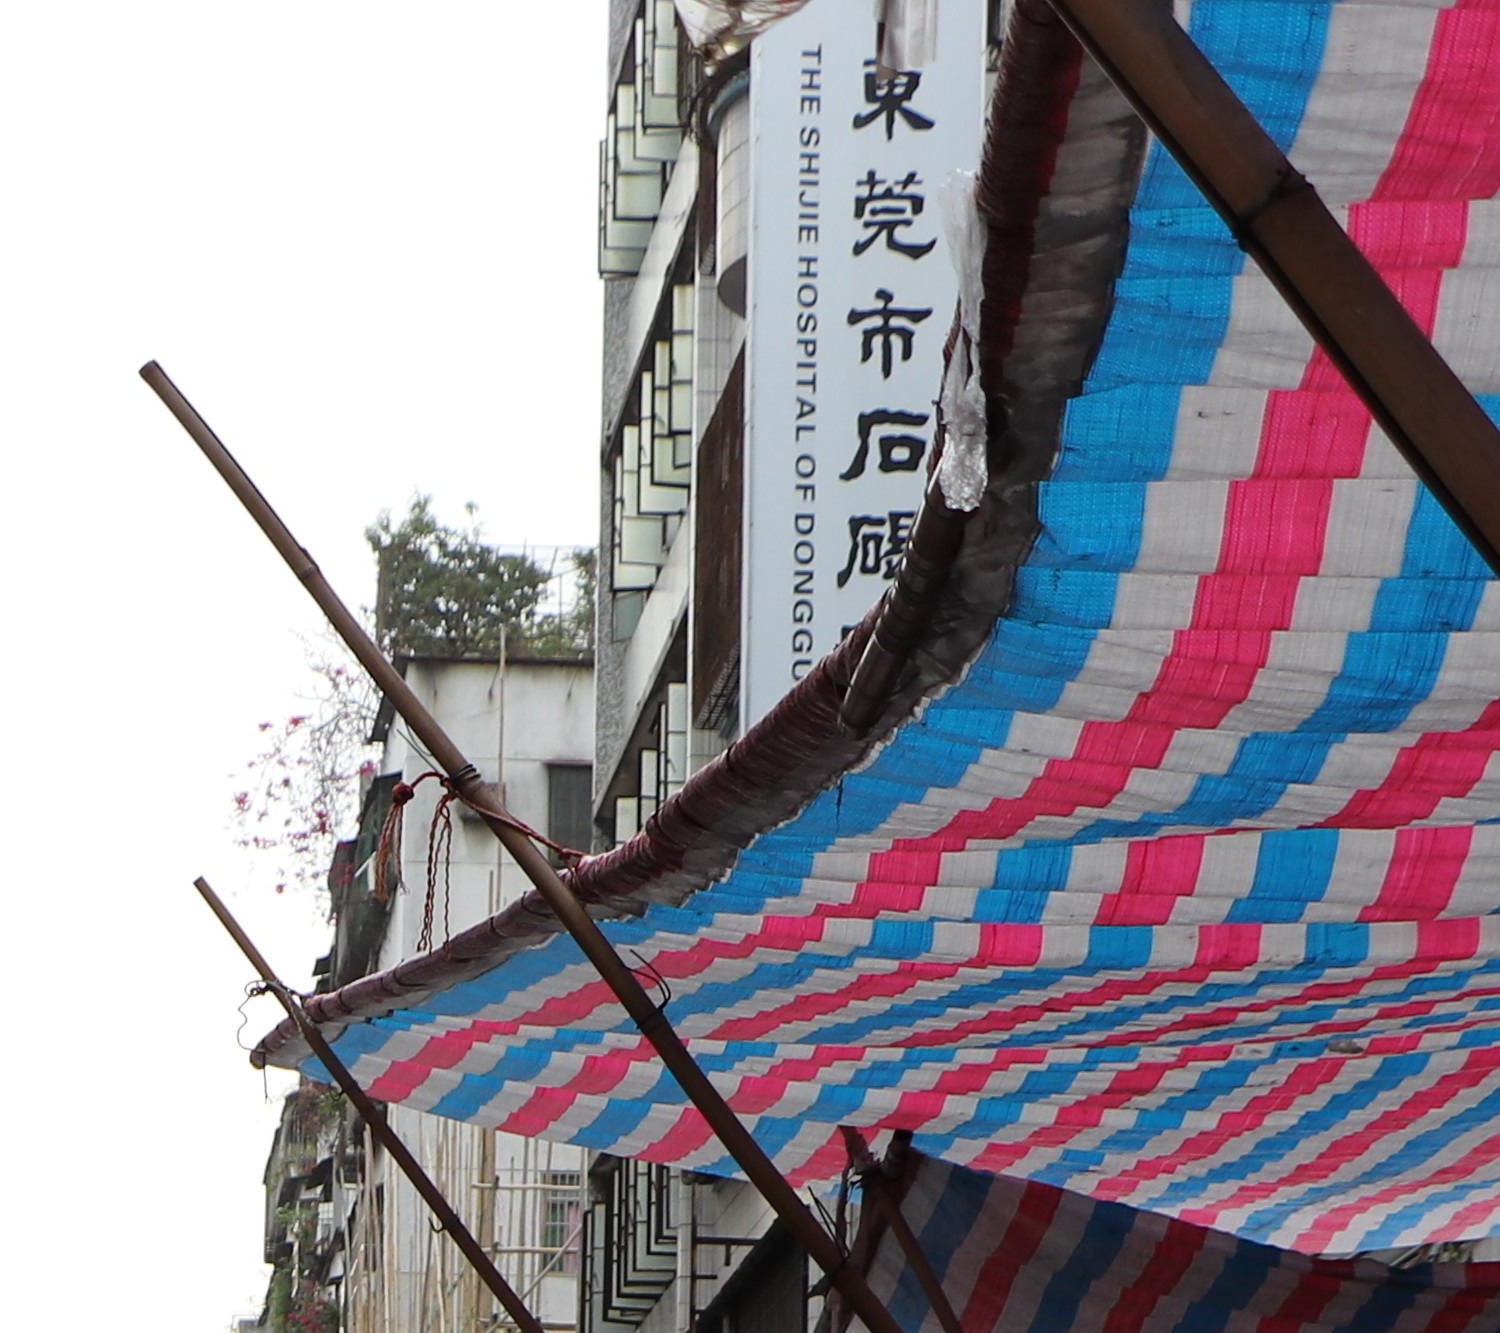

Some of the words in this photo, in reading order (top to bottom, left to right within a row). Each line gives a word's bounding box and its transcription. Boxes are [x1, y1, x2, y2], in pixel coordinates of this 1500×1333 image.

[800, 45, 822, 114] THE
[797, 124, 821, 245] SHIJIE
[795, 255, 820, 442] HOSPITAL
[795, 453, 819, 504] OF
